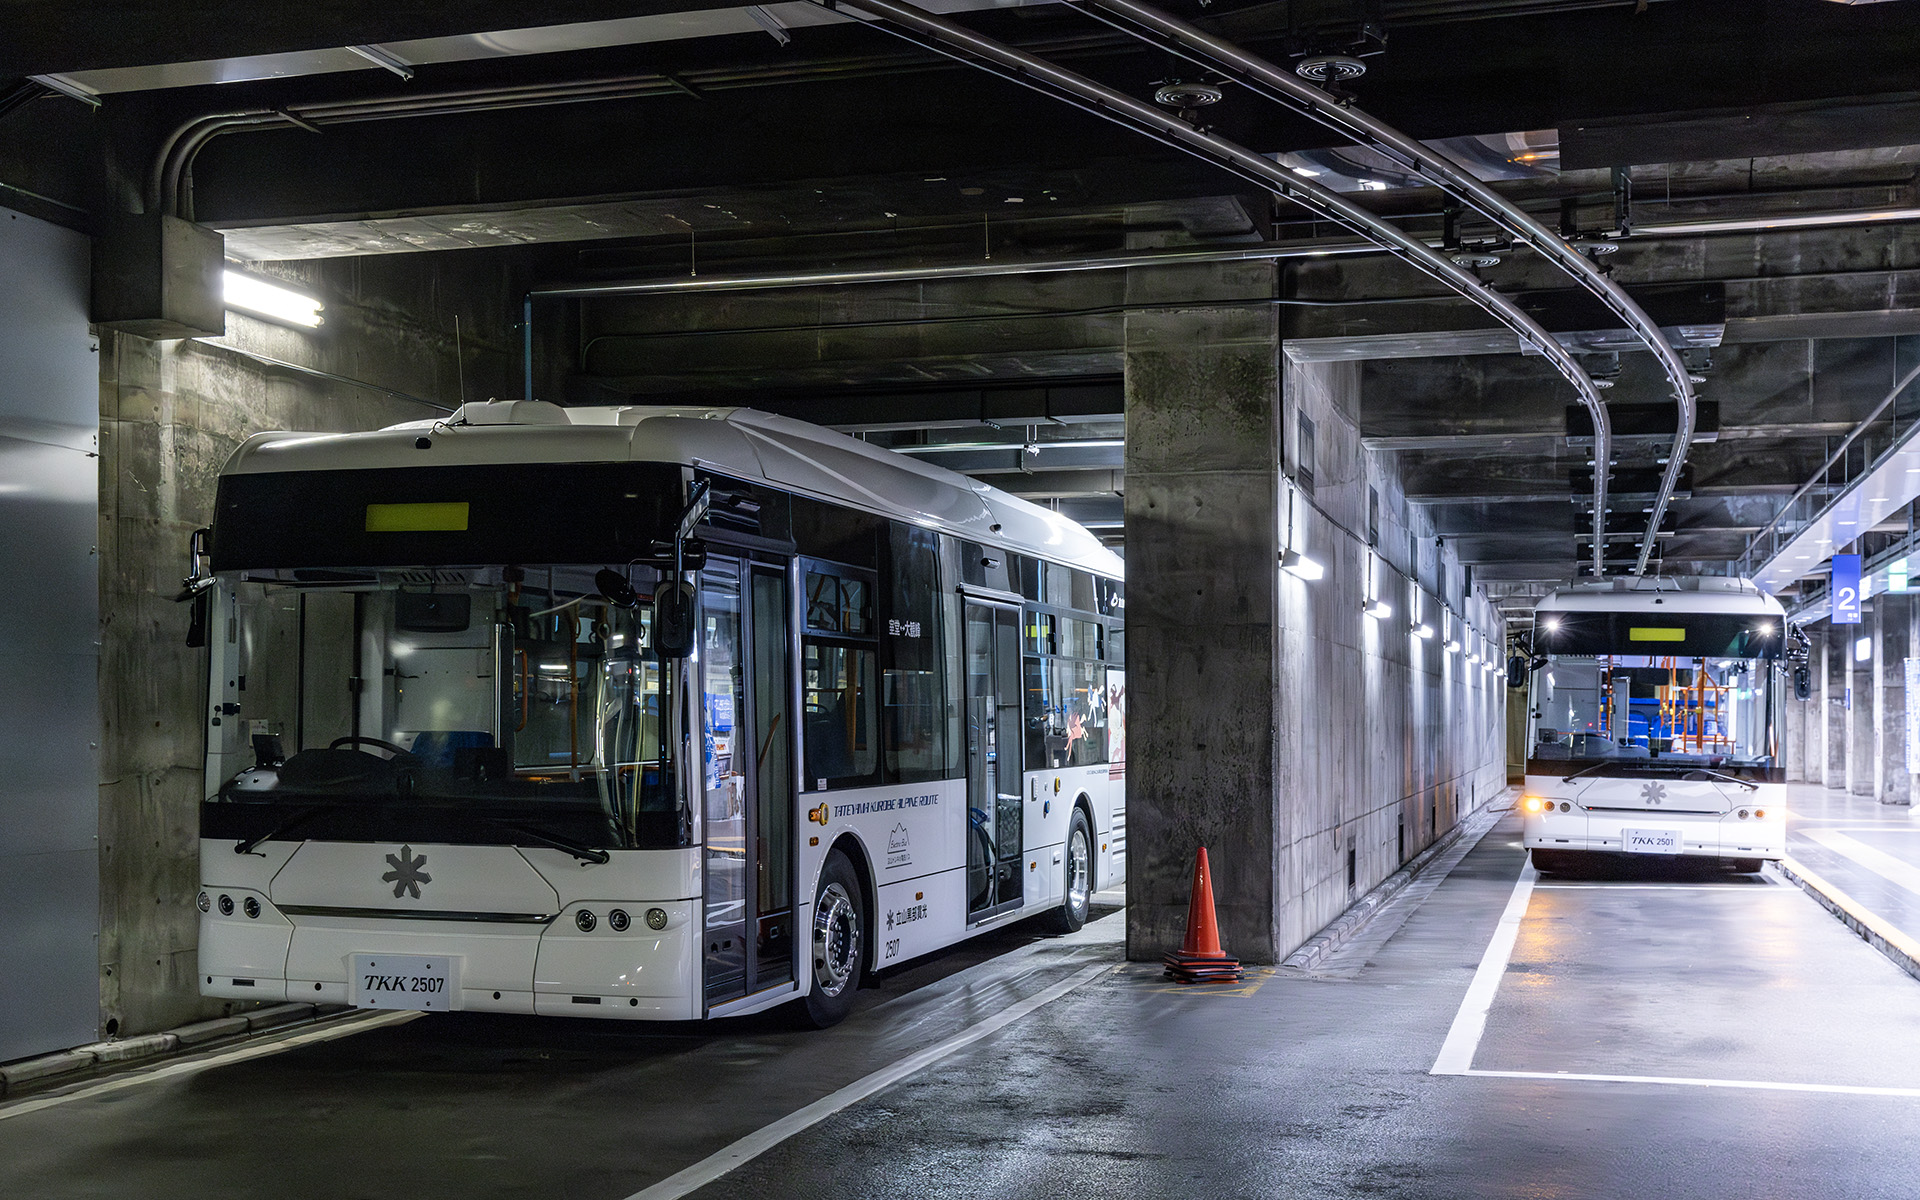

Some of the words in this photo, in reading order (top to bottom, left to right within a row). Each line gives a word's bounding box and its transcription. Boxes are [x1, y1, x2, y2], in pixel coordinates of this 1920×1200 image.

[1838, 587, 1856, 610] 2
[834, 802, 869, 817] TATEYAMA
[870, 799, 896, 812] KUROBE
[897, 796, 919, 809] ALPINE
[919, 794, 939, 806] ROUTE
[1631, 836, 1655, 845] TKK
[1656, 838, 1673, 846] 2501
[885, 938, 900, 959] 2507
[364, 975, 407, 991] TKK
[411, 976, 444, 993] 2507
